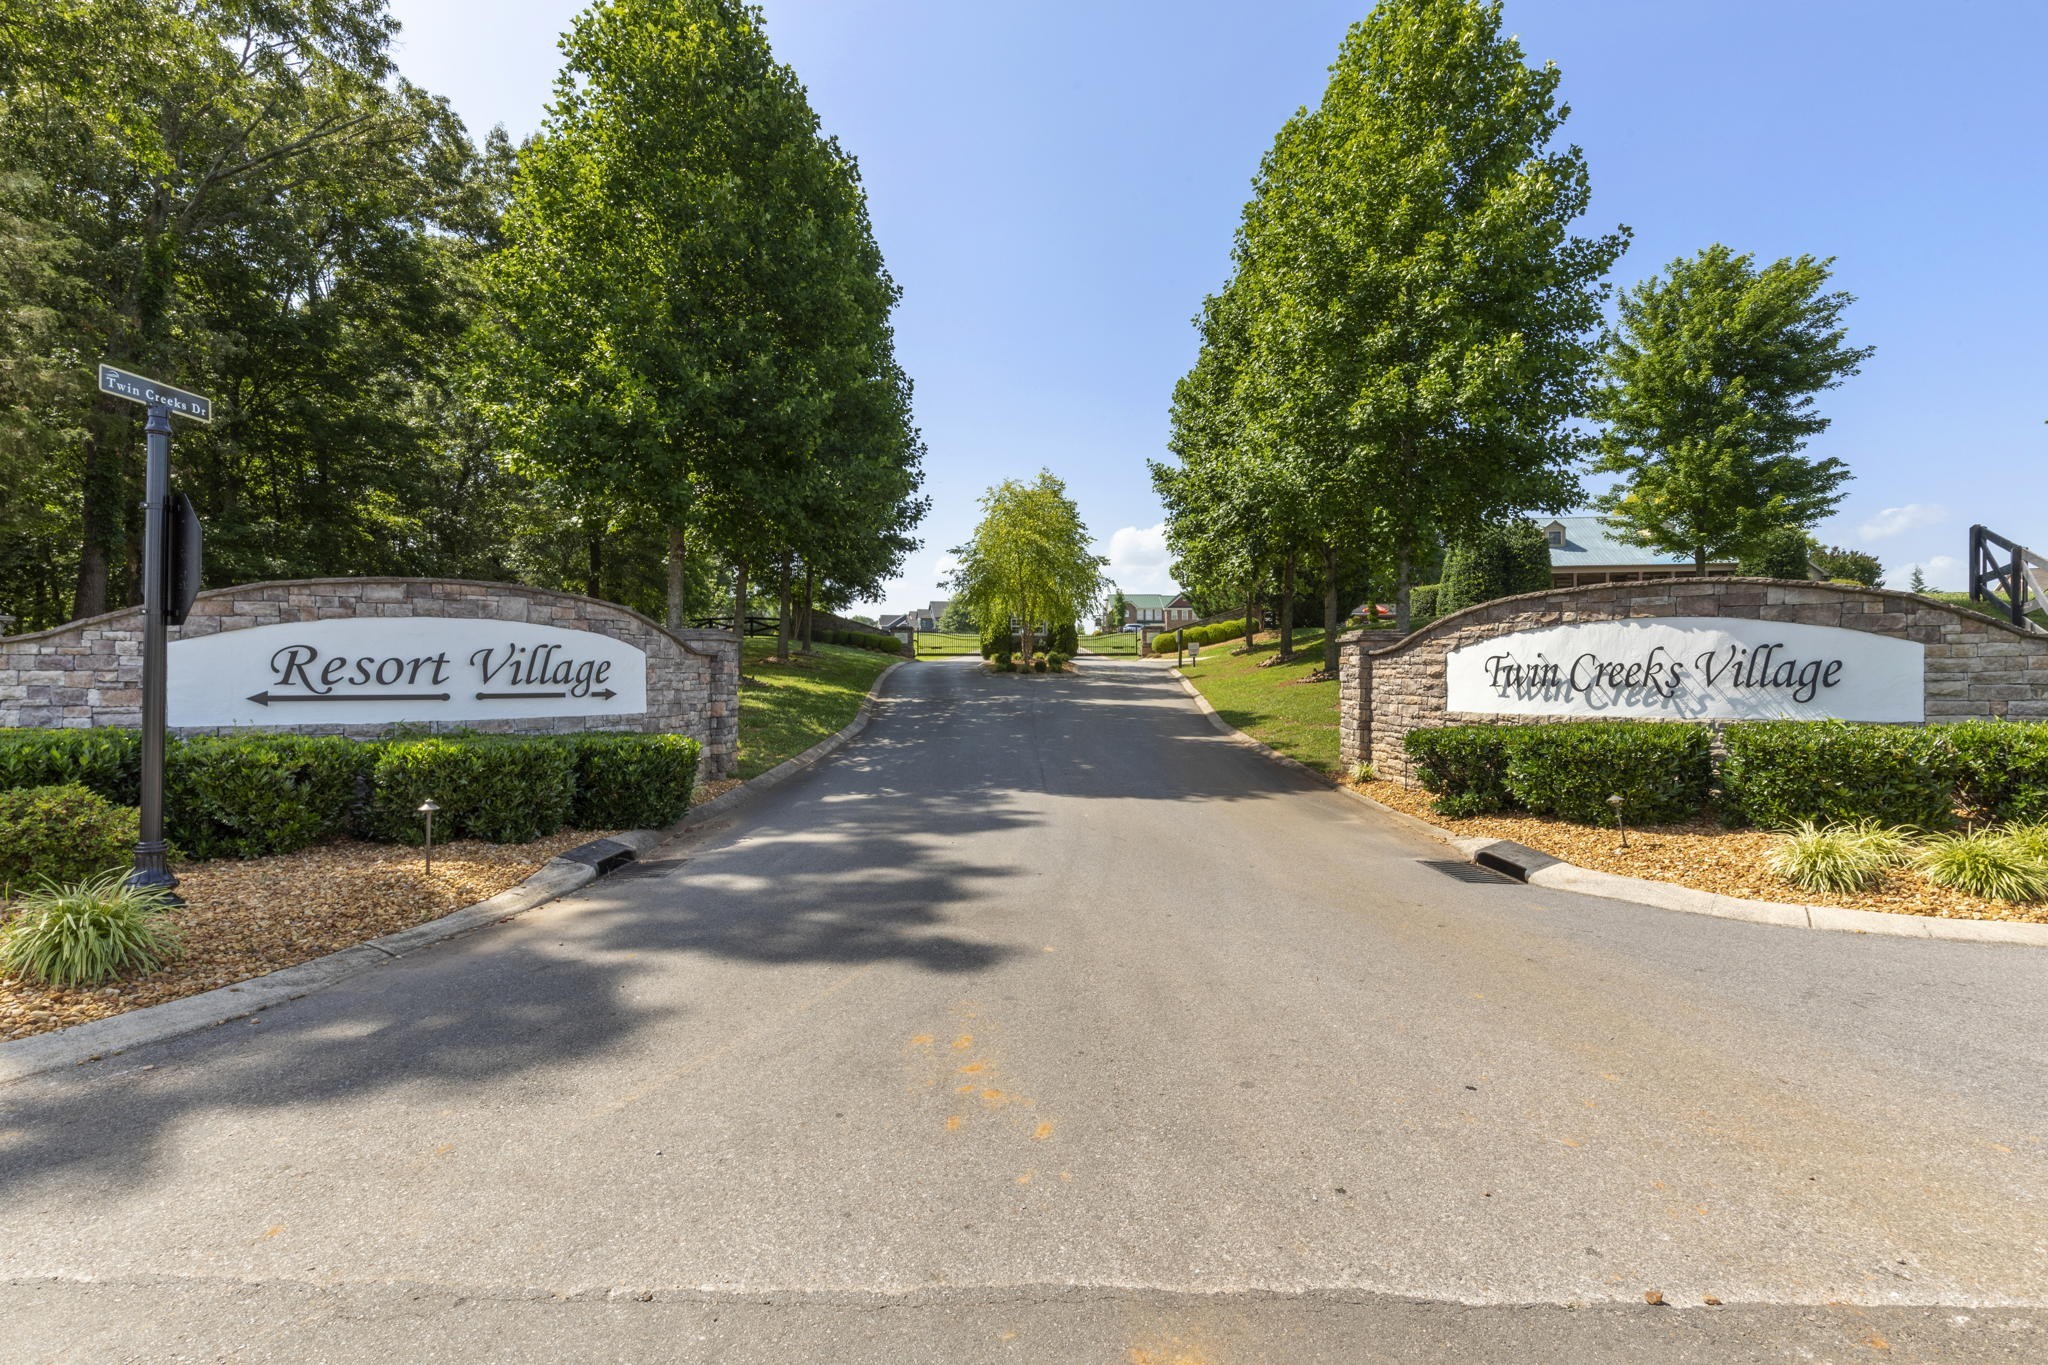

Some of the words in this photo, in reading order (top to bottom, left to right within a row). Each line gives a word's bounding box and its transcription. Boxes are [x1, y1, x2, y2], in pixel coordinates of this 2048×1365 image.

[106, 377, 140, 396] Twin
[145, 389, 187, 410] Creeks
[191, 403, 206, 416] Dr
[270, 644, 450, 694] Resort
[470, 643, 612, 697] Village
[1485, 651, 1559, 687] Twin
[1570, 646, 1683, 698] Creeks
[1695, 643, 1843, 703] Village
